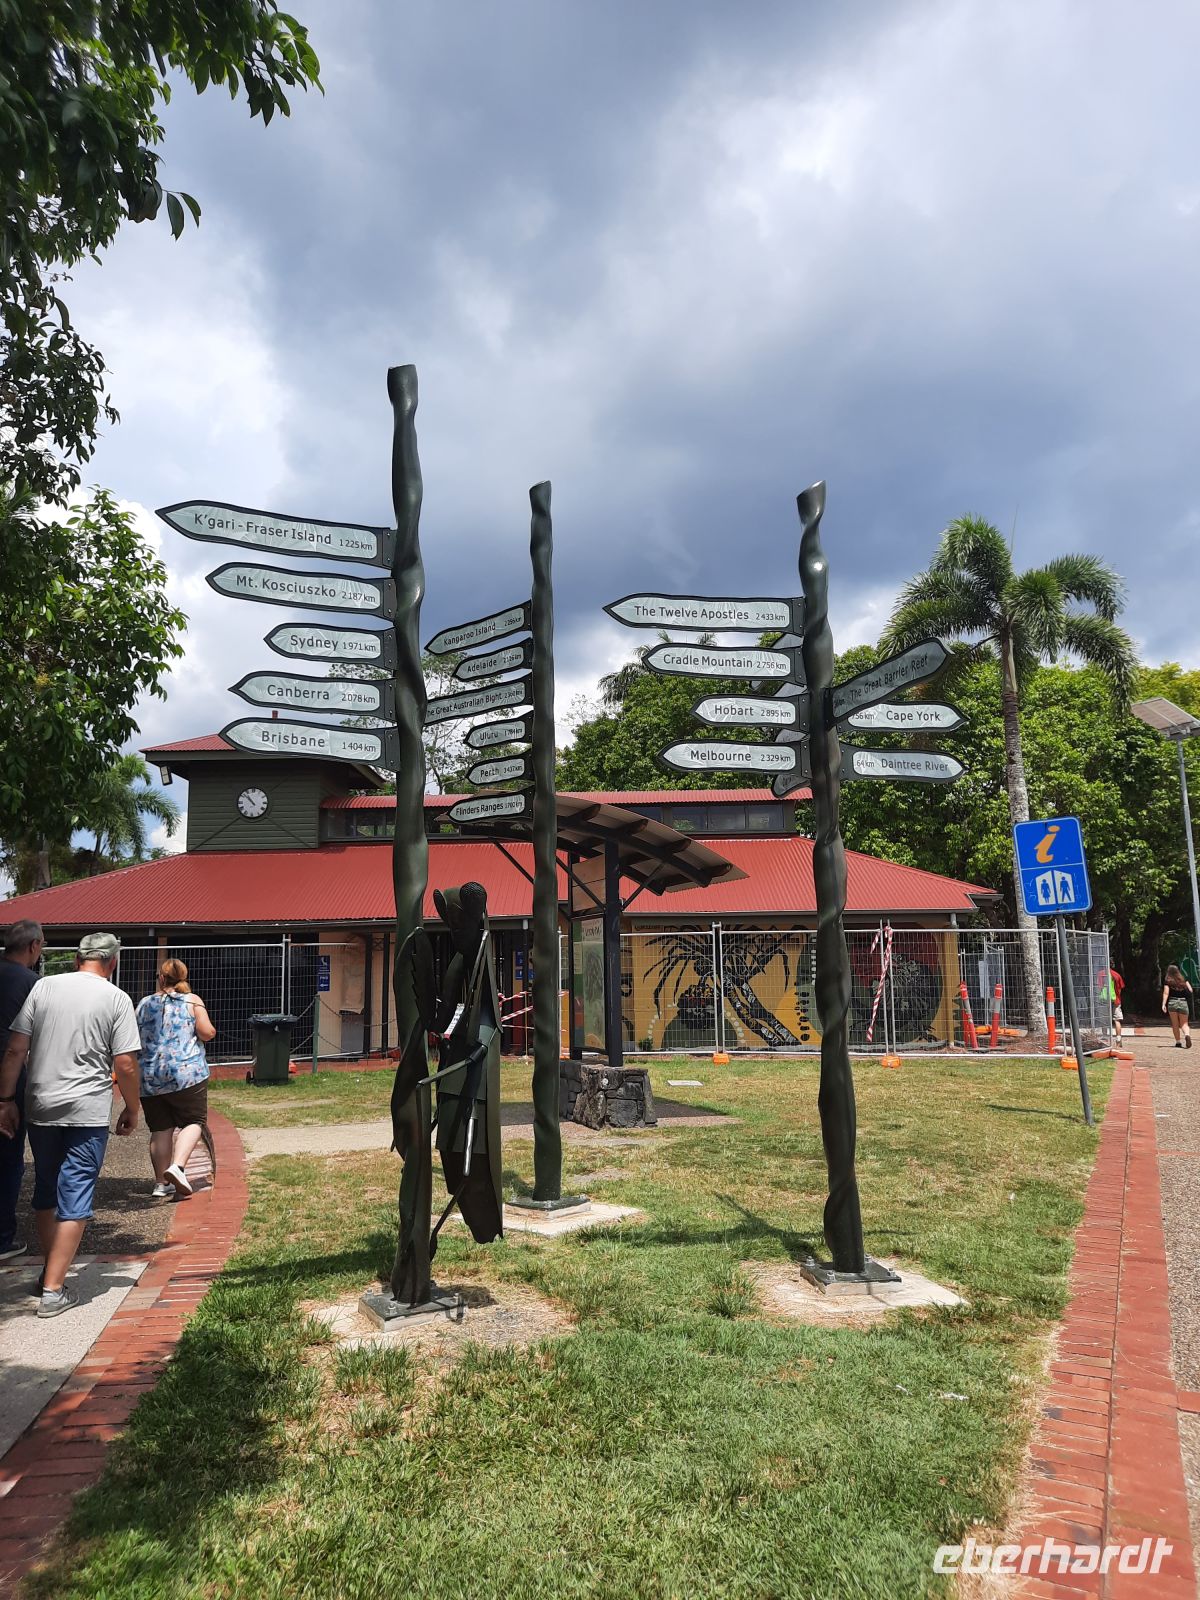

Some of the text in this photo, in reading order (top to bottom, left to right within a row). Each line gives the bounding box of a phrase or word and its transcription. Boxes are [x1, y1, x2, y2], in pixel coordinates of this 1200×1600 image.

[194, 513, 235, 530] K'gari
[246, 521, 288, 538] Fraser
[291, 528, 332, 545] Island
[236, 574, 258, 588] Mt.
[262, 578, 336, 598] Kosciuszko
[634, 606, 656, 617] The
[658, 606, 698, 618] Twelve
[700, 608, 749, 620] Apostles
[444, 631, 474, 646] Kangaroo
[476, 622, 496, 637] Island
[290, 634, 338, 651] Sydney
[467, 658, 497, 673] Adelaide
[663, 654, 700, 666] Cradle
[701, 656, 753, 668] Mountain
[850, 689, 862, 700] The
[864, 678, 882, 694] Great
[884, 665, 908, 685] Barrier
[267, 684, 330, 700] Canberra
[436, 703, 452, 714] Great
[454, 697, 484, 710] Australian
[486, 692, 502, 704] Bight
[714, 704, 754, 716] Hobart
[886, 710, 913, 722] Cape
[917, 711, 941, 722] York
[262, 730, 325, 748] Brisbane
[480, 731, 499, 741] Uluru
[690, 750, 752, 762] Melbourne
[881, 758, 922, 769] Daintree
[925, 760, 948, 772] River
[480, 768, 500, 778] Perth
[456, 804, 480, 816] Flinders
[480, 802, 504, 813] Ranges
